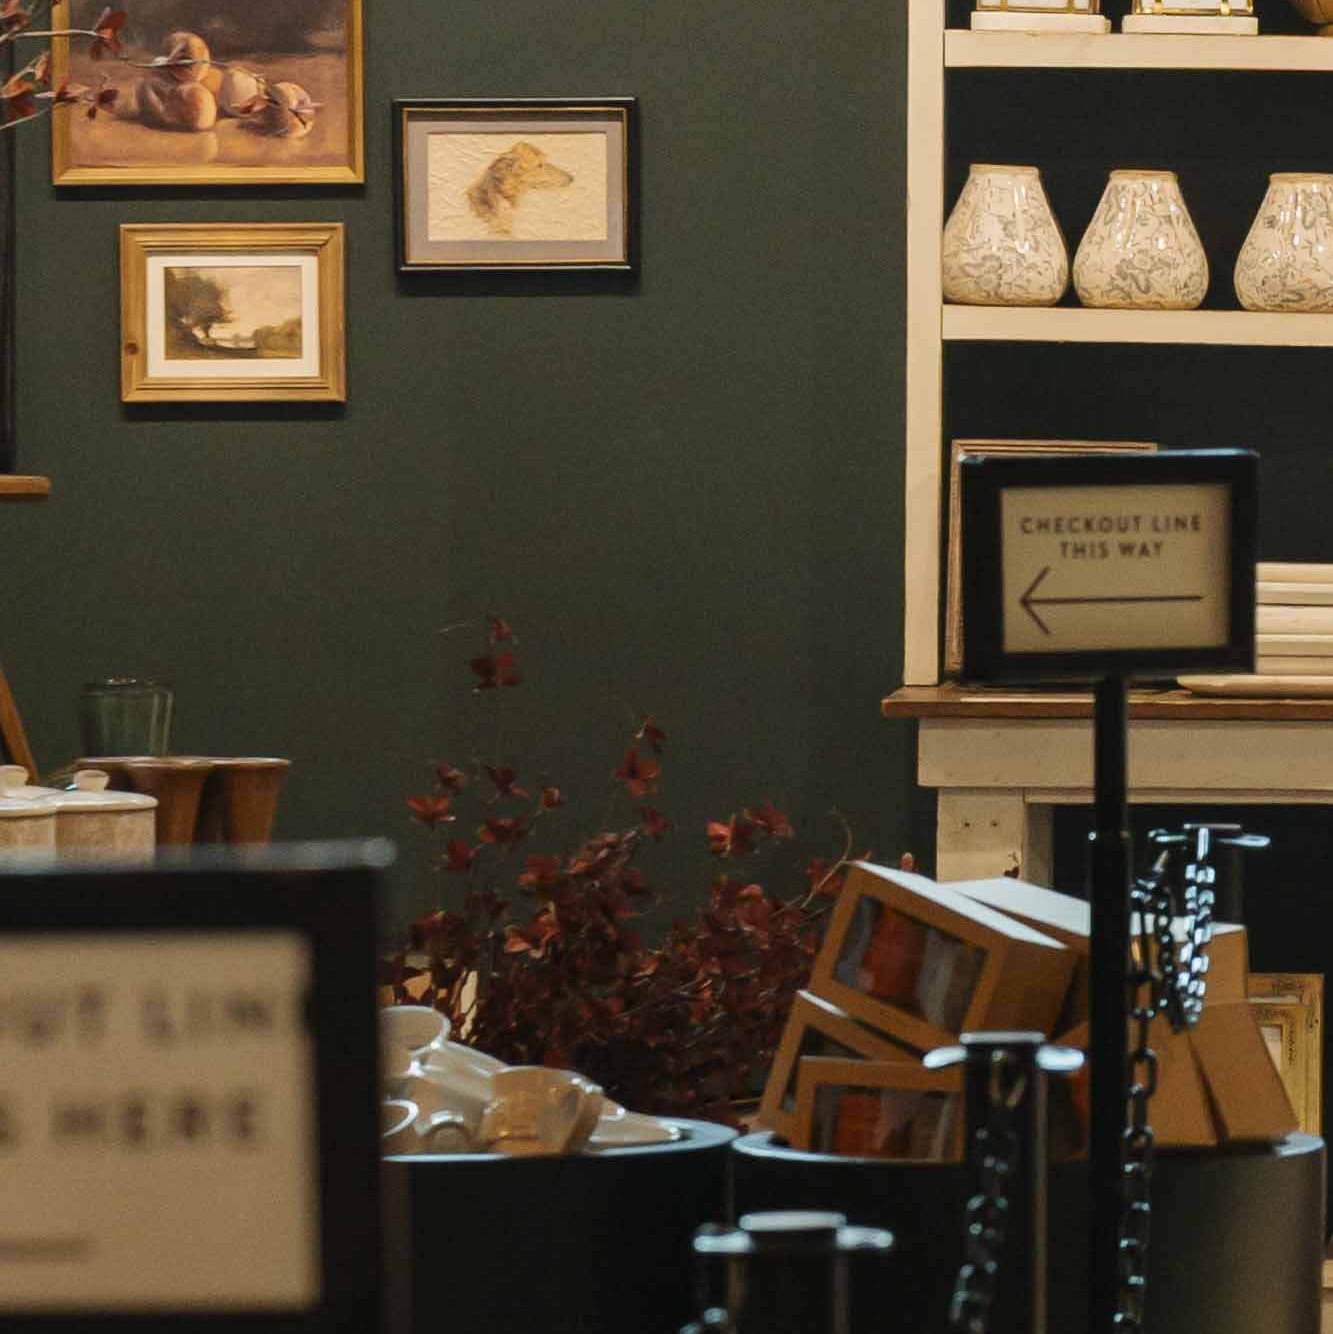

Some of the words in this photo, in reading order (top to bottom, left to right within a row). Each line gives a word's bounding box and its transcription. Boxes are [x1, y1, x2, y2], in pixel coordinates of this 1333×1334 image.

[1019, 515, 1143, 535] CHECKOUT
[1151, 514, 1202, 533] LINE
[1059, 539, 1109, 559] THIS
[1117, 539, 1164, 557] WAY
